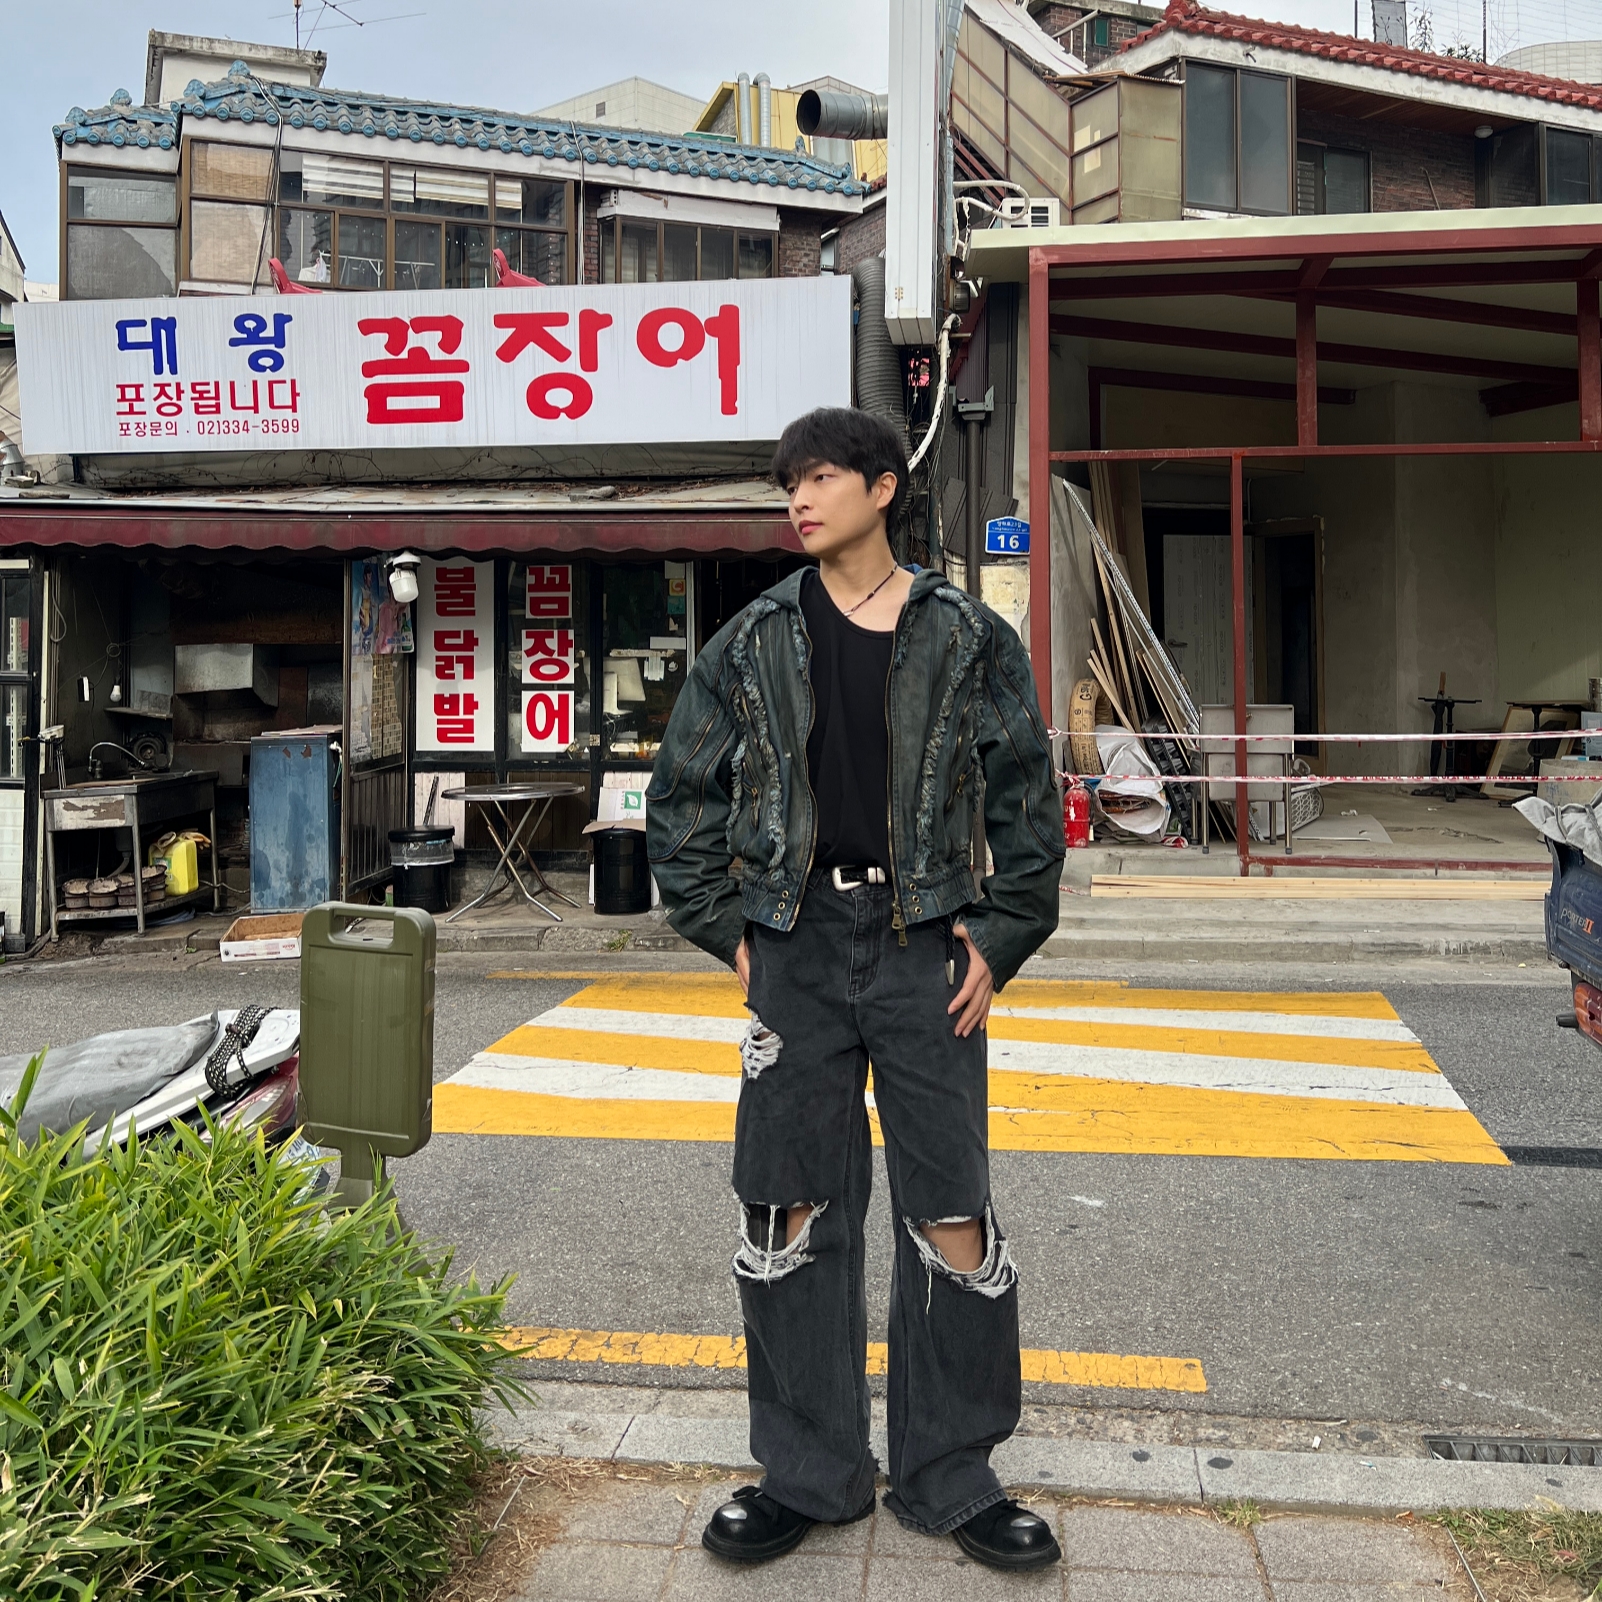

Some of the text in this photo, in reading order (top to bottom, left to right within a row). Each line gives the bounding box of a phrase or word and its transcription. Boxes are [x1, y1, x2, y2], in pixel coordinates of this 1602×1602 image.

[116, 379, 301, 417] 포장됩니다
[357, 304, 740, 425] 꼼장어
[119, 418, 300, 437] 포장문의 02)334-3599
[997, 534, 1020, 549] 16
[434, 567, 479, 744] 불닭발
[524, 566, 574, 745] 꼼장어
